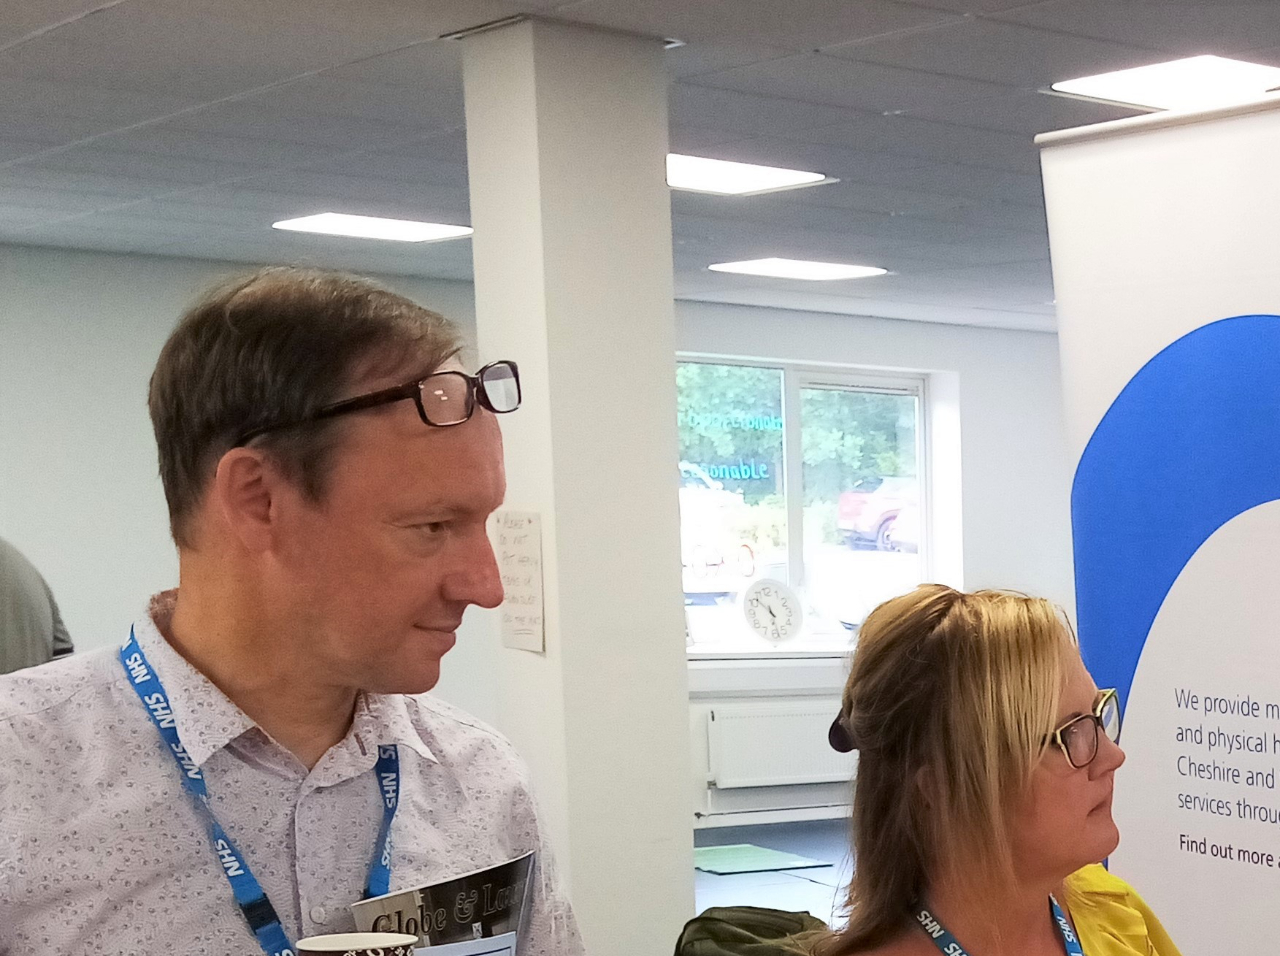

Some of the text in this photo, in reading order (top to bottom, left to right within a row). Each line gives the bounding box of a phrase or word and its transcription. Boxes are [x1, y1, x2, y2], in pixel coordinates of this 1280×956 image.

[125, 650, 151, 684] NHS
[144, 692, 175, 729] NHS
[1175, 688, 1199, 710] We
[1204, 695, 1260, 717] provide
[1176, 724, 1203, 745] and
[1208, 727, 1267, 754] physical
[1177, 756, 1240, 784] Cheshire
[1246, 768, 1274, 789] and
[381, 772, 398, 808] NHS
[1178, 792, 1232, 816] services
[214, 838, 245, 878] NHS
[1180, 835, 1206, 855] Find
[1211, 842, 1233, 861] out
[1238, 849, 1273, 868] more
[454, 889, 478, 923] &
